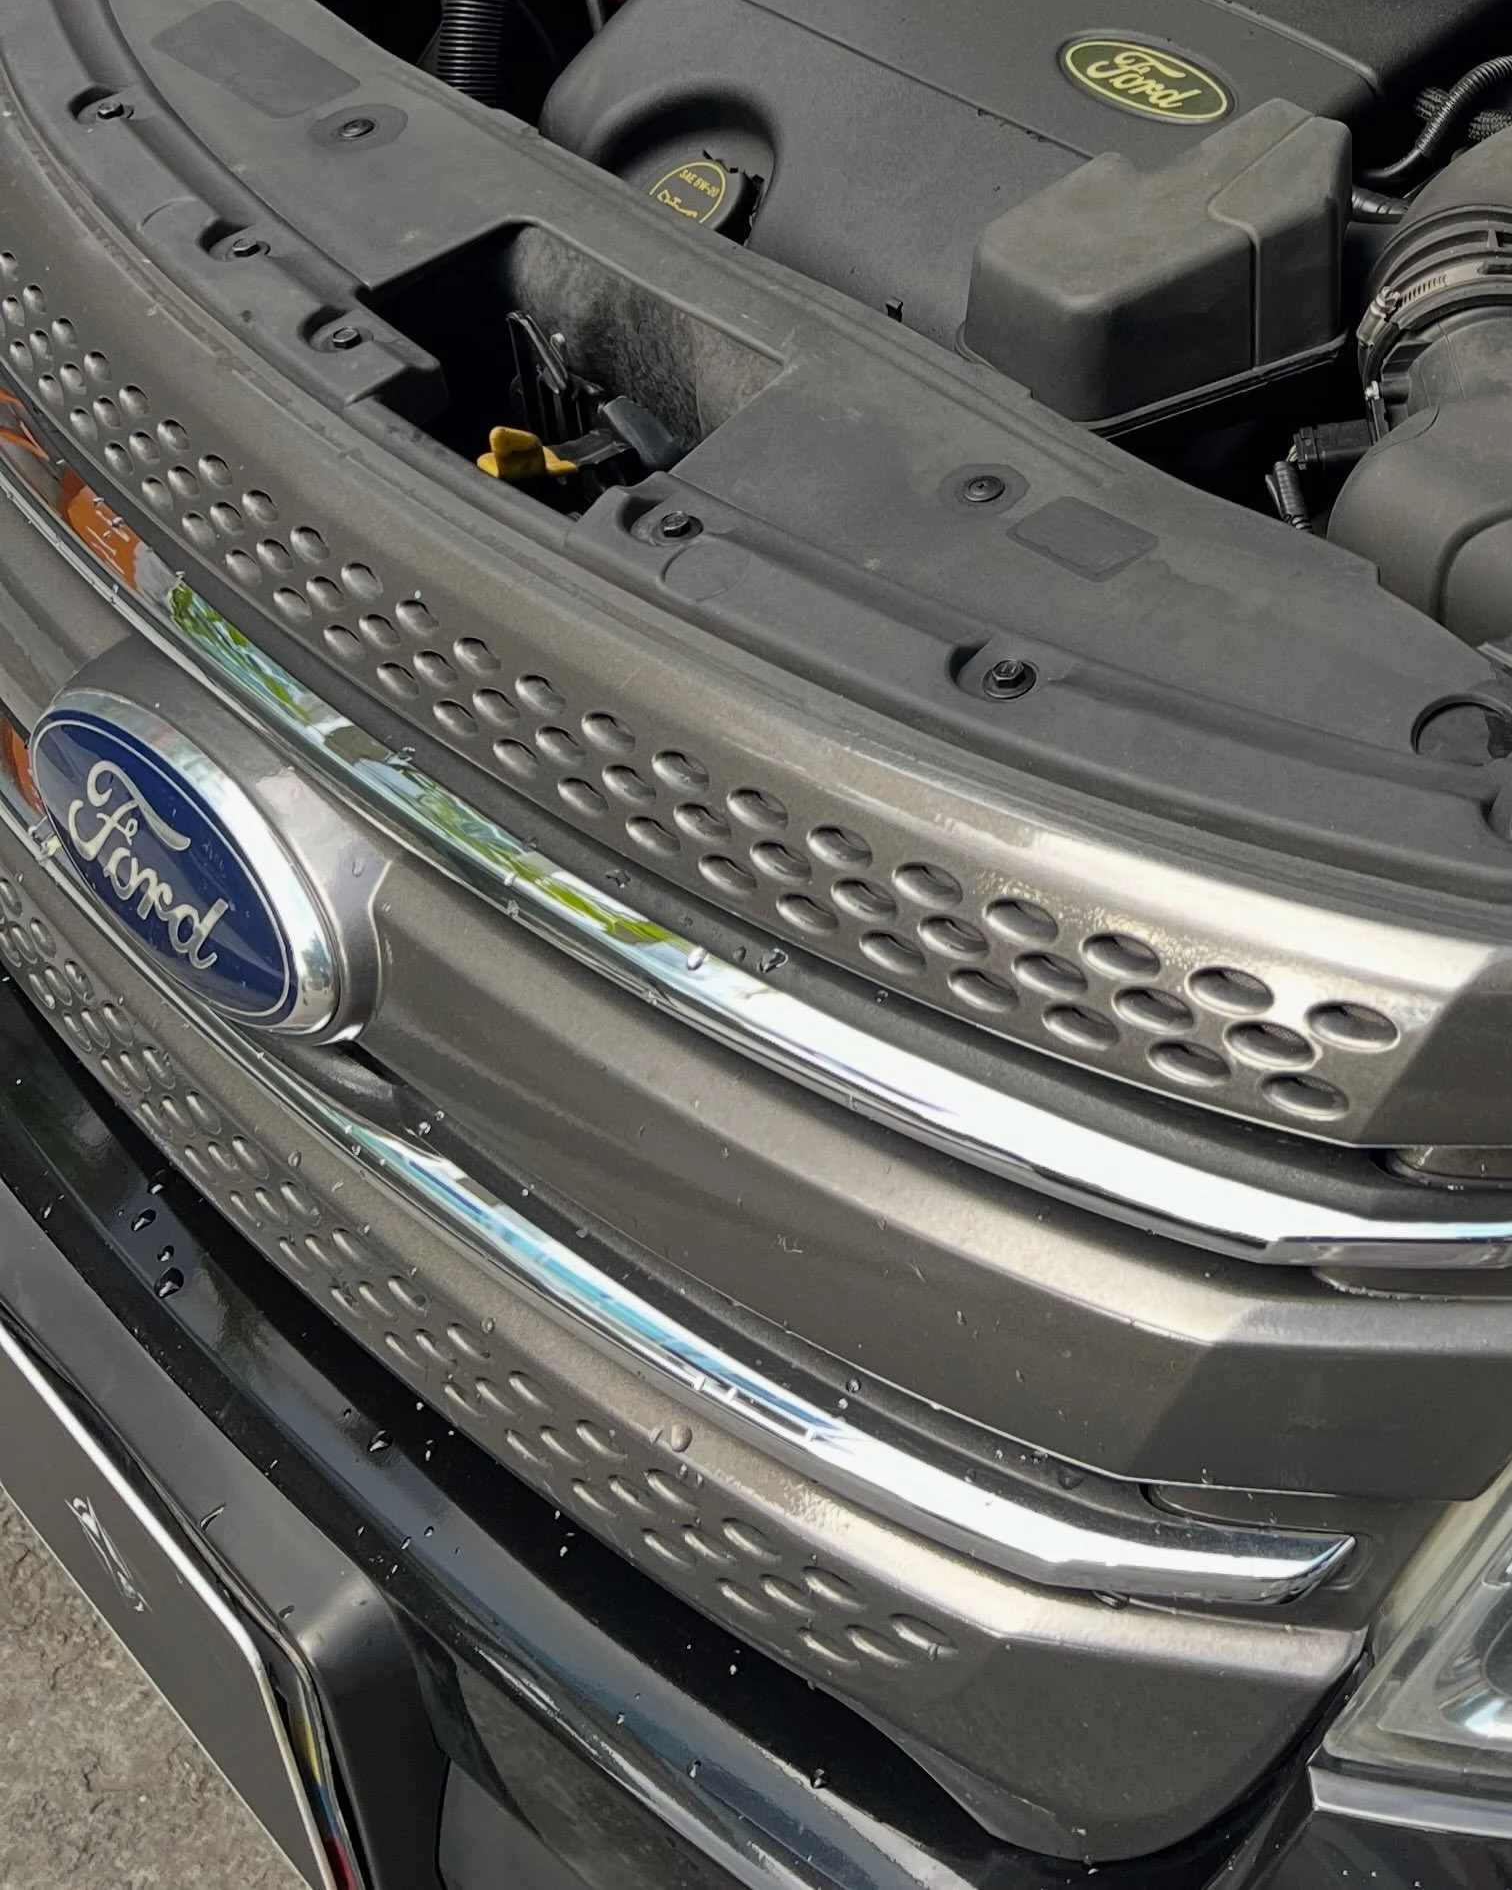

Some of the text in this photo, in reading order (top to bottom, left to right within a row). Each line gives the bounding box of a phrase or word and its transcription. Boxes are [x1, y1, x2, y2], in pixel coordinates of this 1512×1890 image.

[1086, 51, 1203, 109] Ford
[679, 168, 697, 185] SAE
[68, 760, 230, 970] Ford
